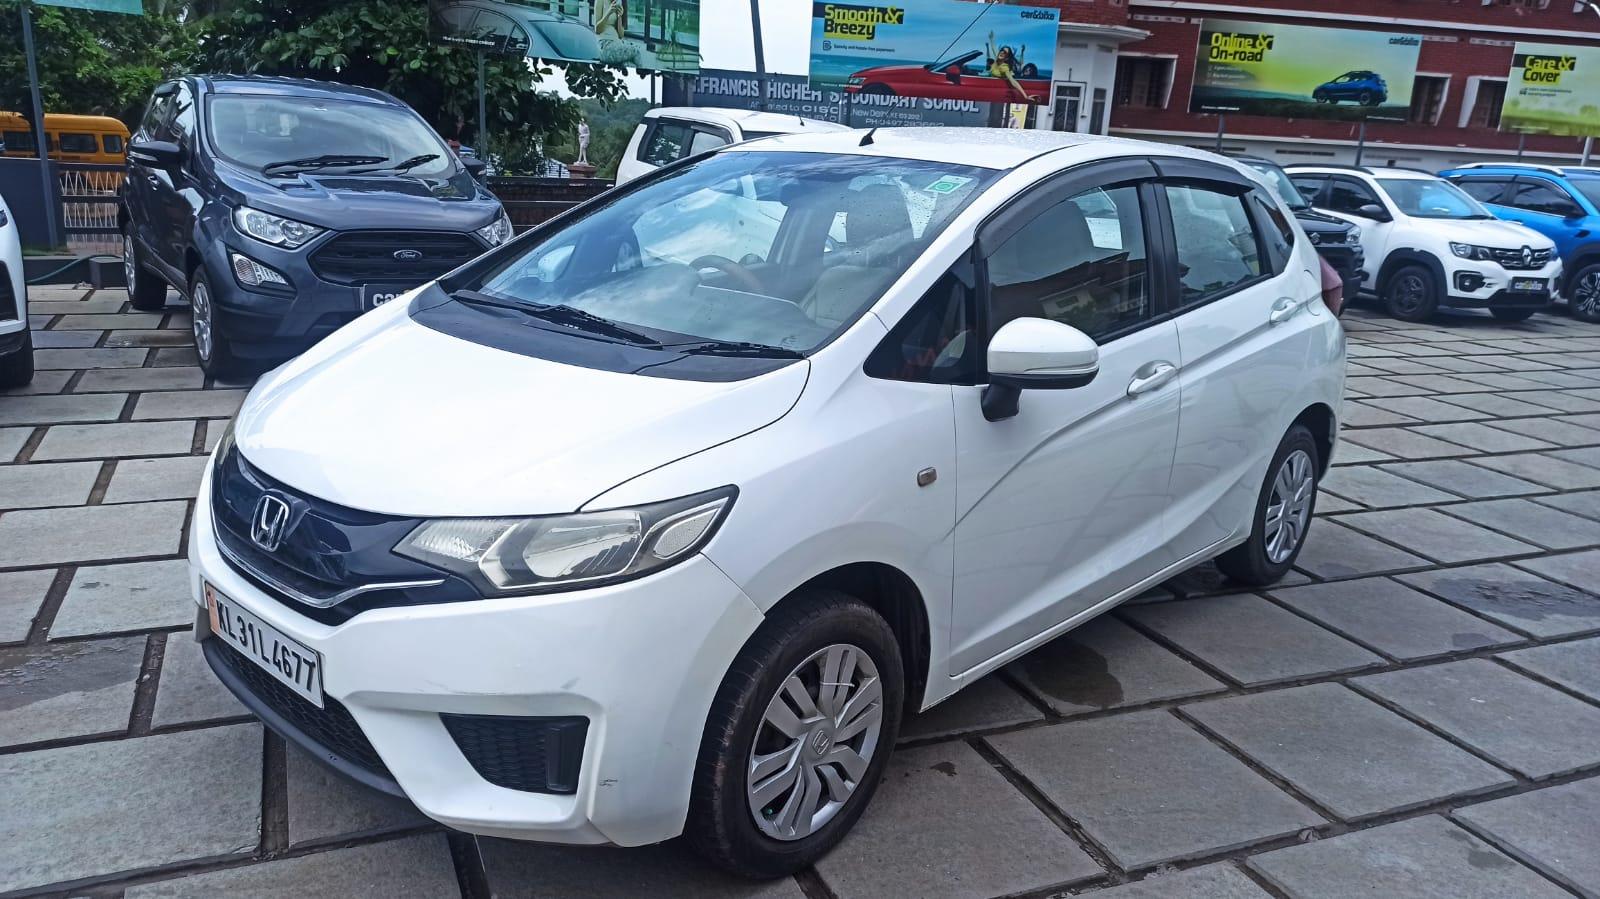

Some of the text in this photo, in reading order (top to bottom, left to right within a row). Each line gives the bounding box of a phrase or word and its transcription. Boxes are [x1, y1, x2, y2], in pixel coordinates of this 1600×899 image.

[825, 5, 904, 24] Smooth &
[824, 20, 875, 40] Breezy
[1211, 32, 1275, 48] Online &
[1210, 46, 1265, 62] On-road
[1525, 55, 1575, 71] Care &
[1522, 68, 1560, 82] Cover
